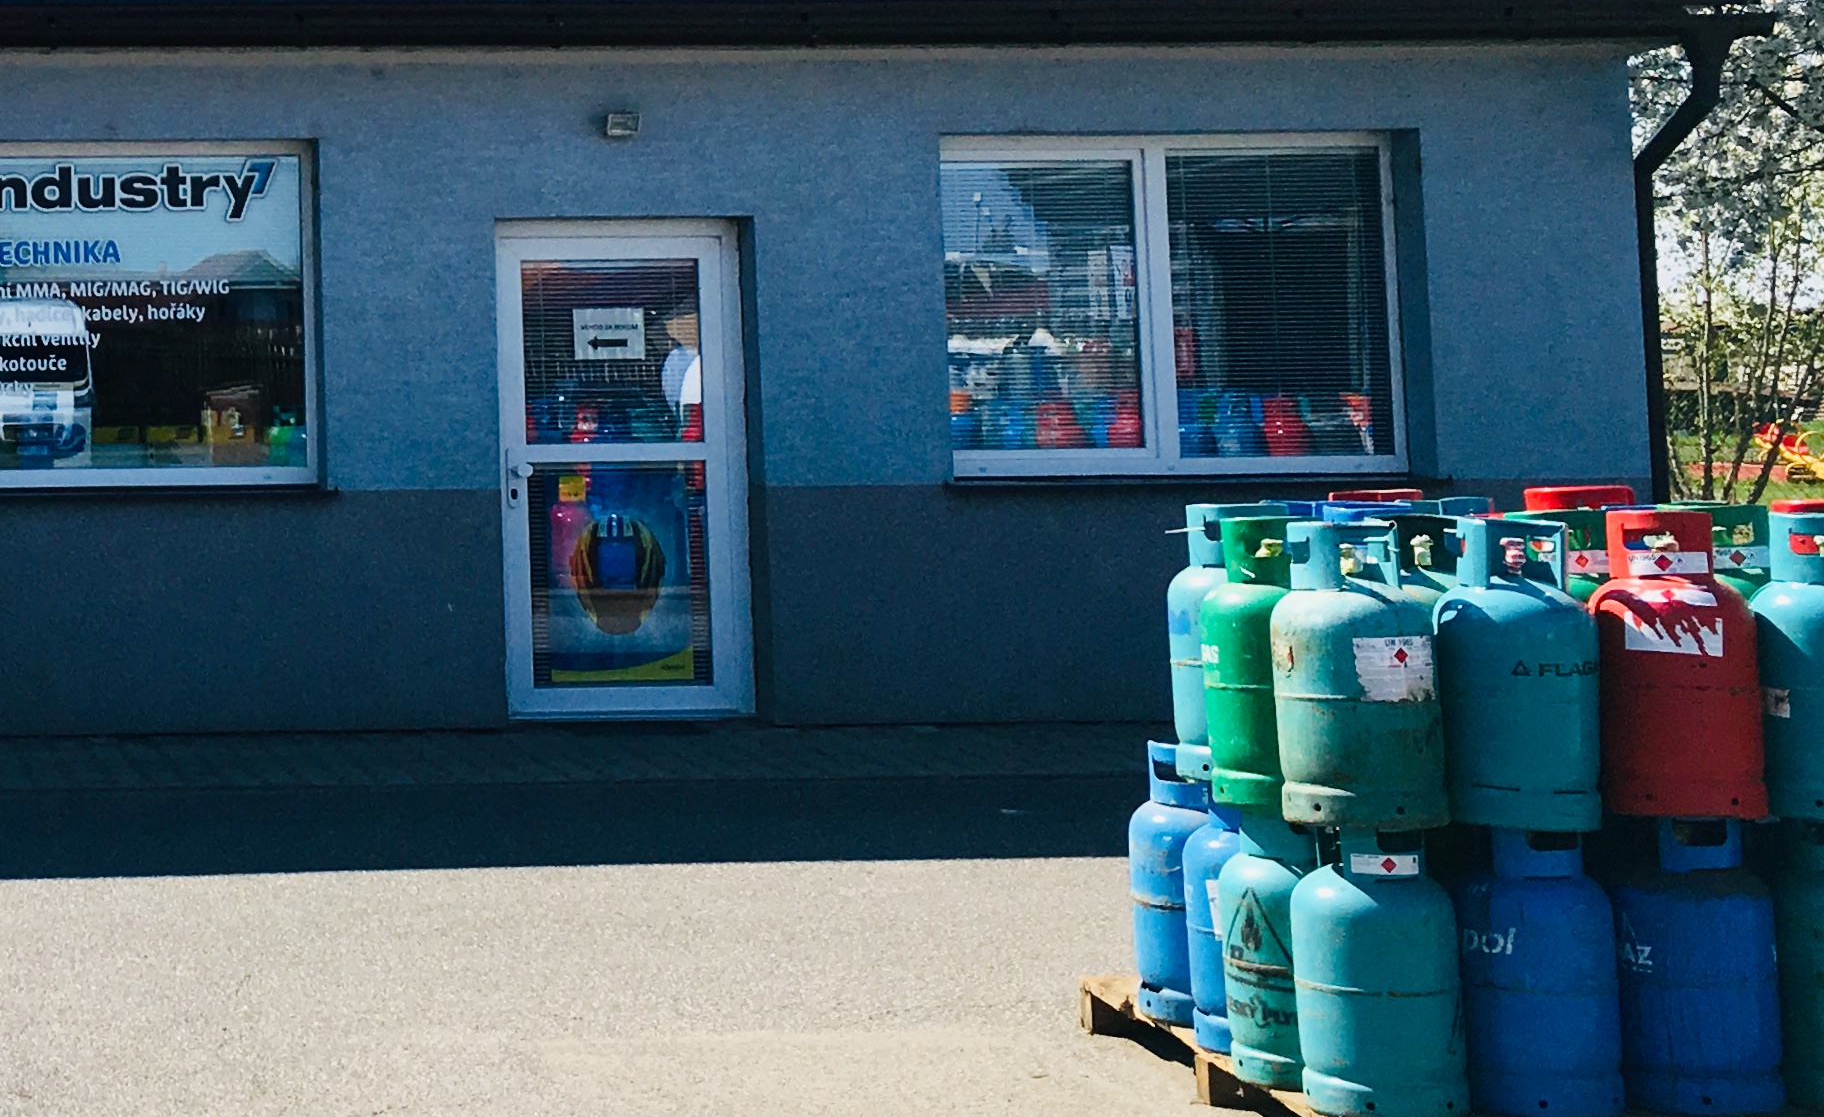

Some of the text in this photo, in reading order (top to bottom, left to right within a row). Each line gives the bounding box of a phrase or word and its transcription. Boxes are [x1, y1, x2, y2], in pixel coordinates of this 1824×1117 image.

[16, 283, 66, 300] MMA,
[70, 280, 157, 298] MIG/MAG,
[159, 279, 230, 297] TIG/WIG
[81, 304, 144, 323] kabely,
[147, 302, 206, 322] hořáky
